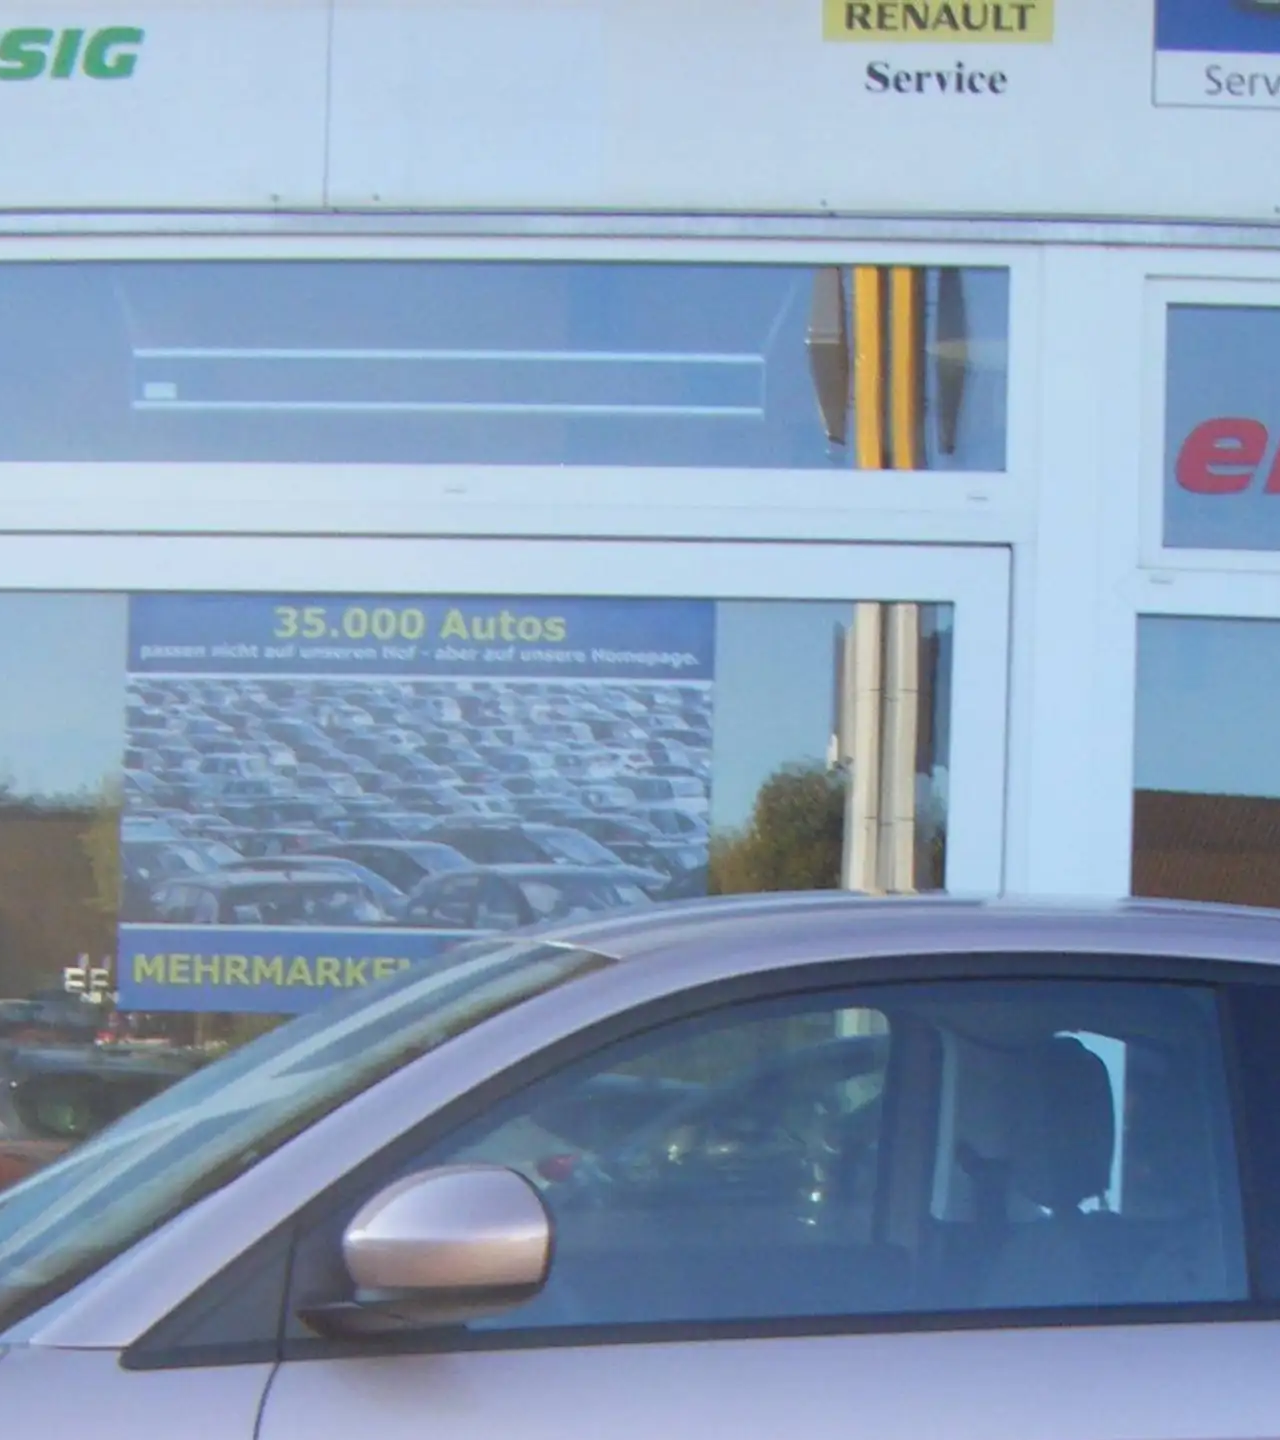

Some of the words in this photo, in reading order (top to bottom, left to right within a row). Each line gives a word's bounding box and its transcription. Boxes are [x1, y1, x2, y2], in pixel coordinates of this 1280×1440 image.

[844, 1, 1036, 32] RENAULT
[864, 60, 1008, 95] Service
[274, 606, 425, 640] 35.000
[439, 608, 567, 642] Autos
